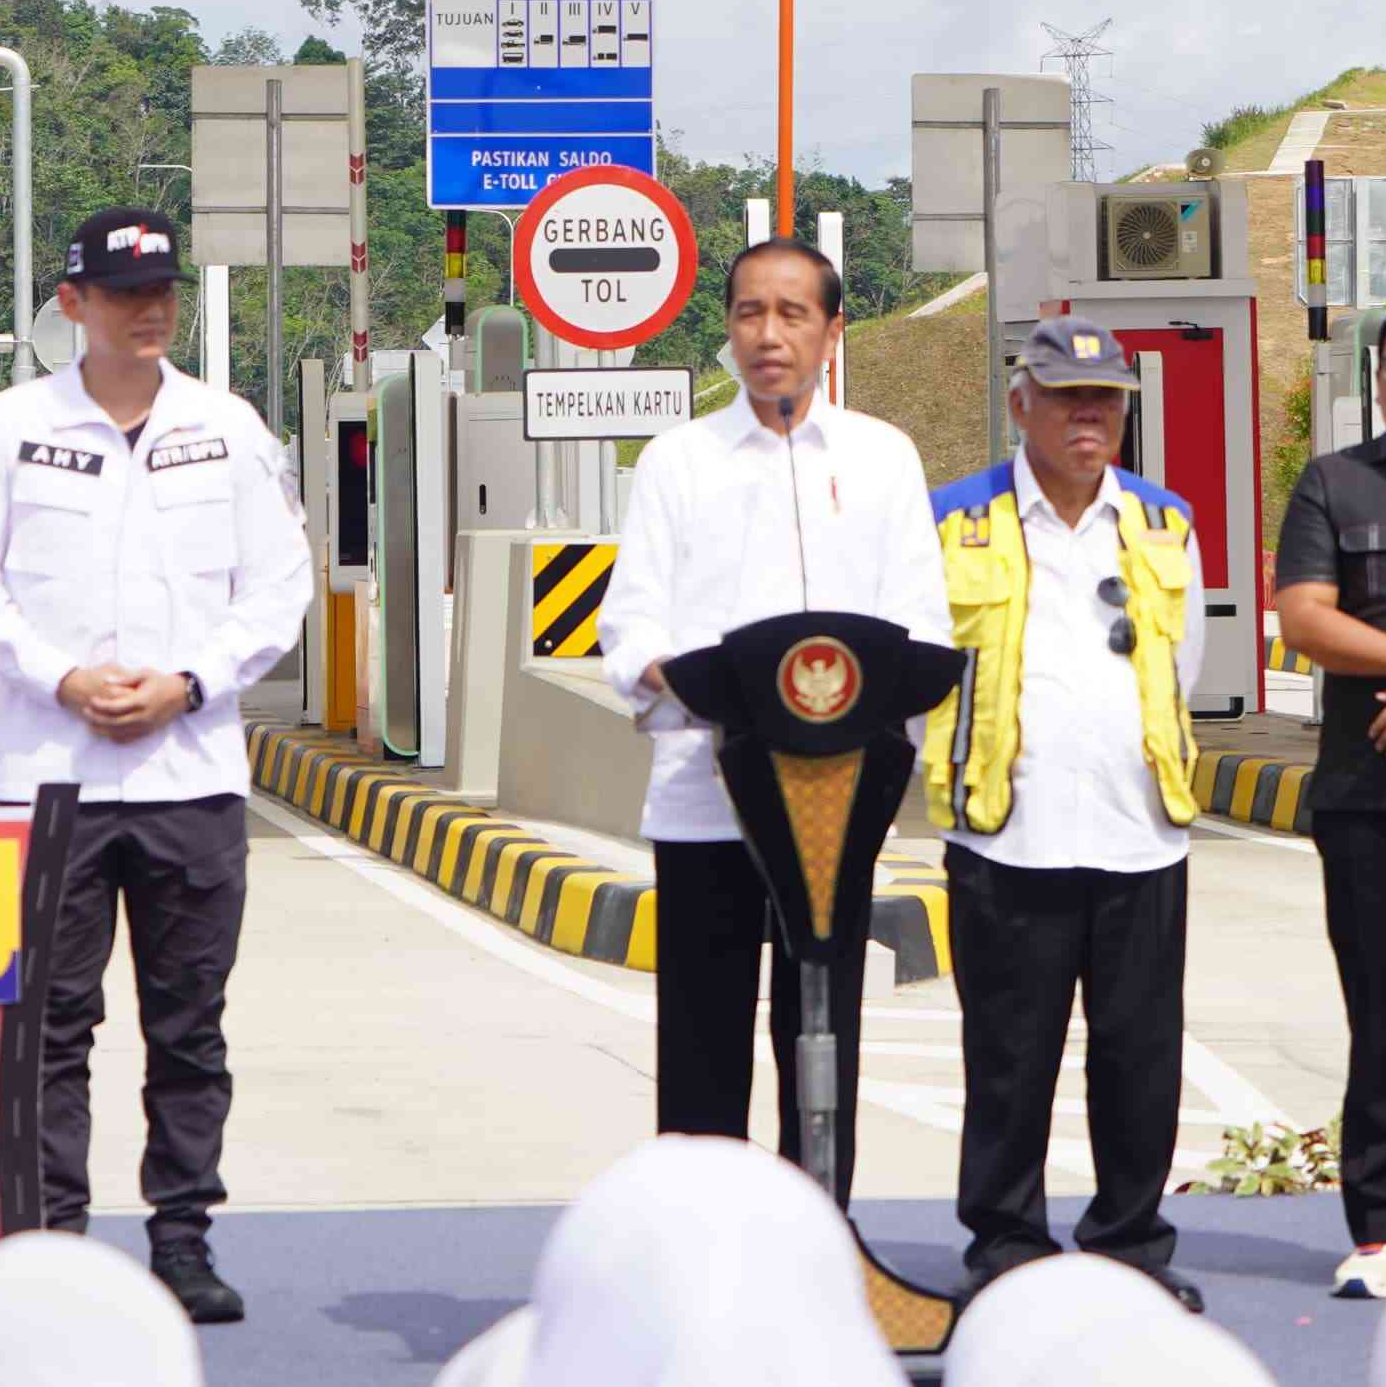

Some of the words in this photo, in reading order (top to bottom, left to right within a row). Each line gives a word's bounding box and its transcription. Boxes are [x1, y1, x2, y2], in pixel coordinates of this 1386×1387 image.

[436, 13, 494, 26] TUJUAN
[472, 151, 549, 167] PASTIKAN
[559, 151, 612, 166] SALDO
[483, 173, 538, 190] E-TOLL
[544, 218, 665, 242] GERBANG
[581, 279, 627, 303] TOL
[537, 392, 626, 417] TEMPELKAN
[633, 390, 682, 415] KARTU
